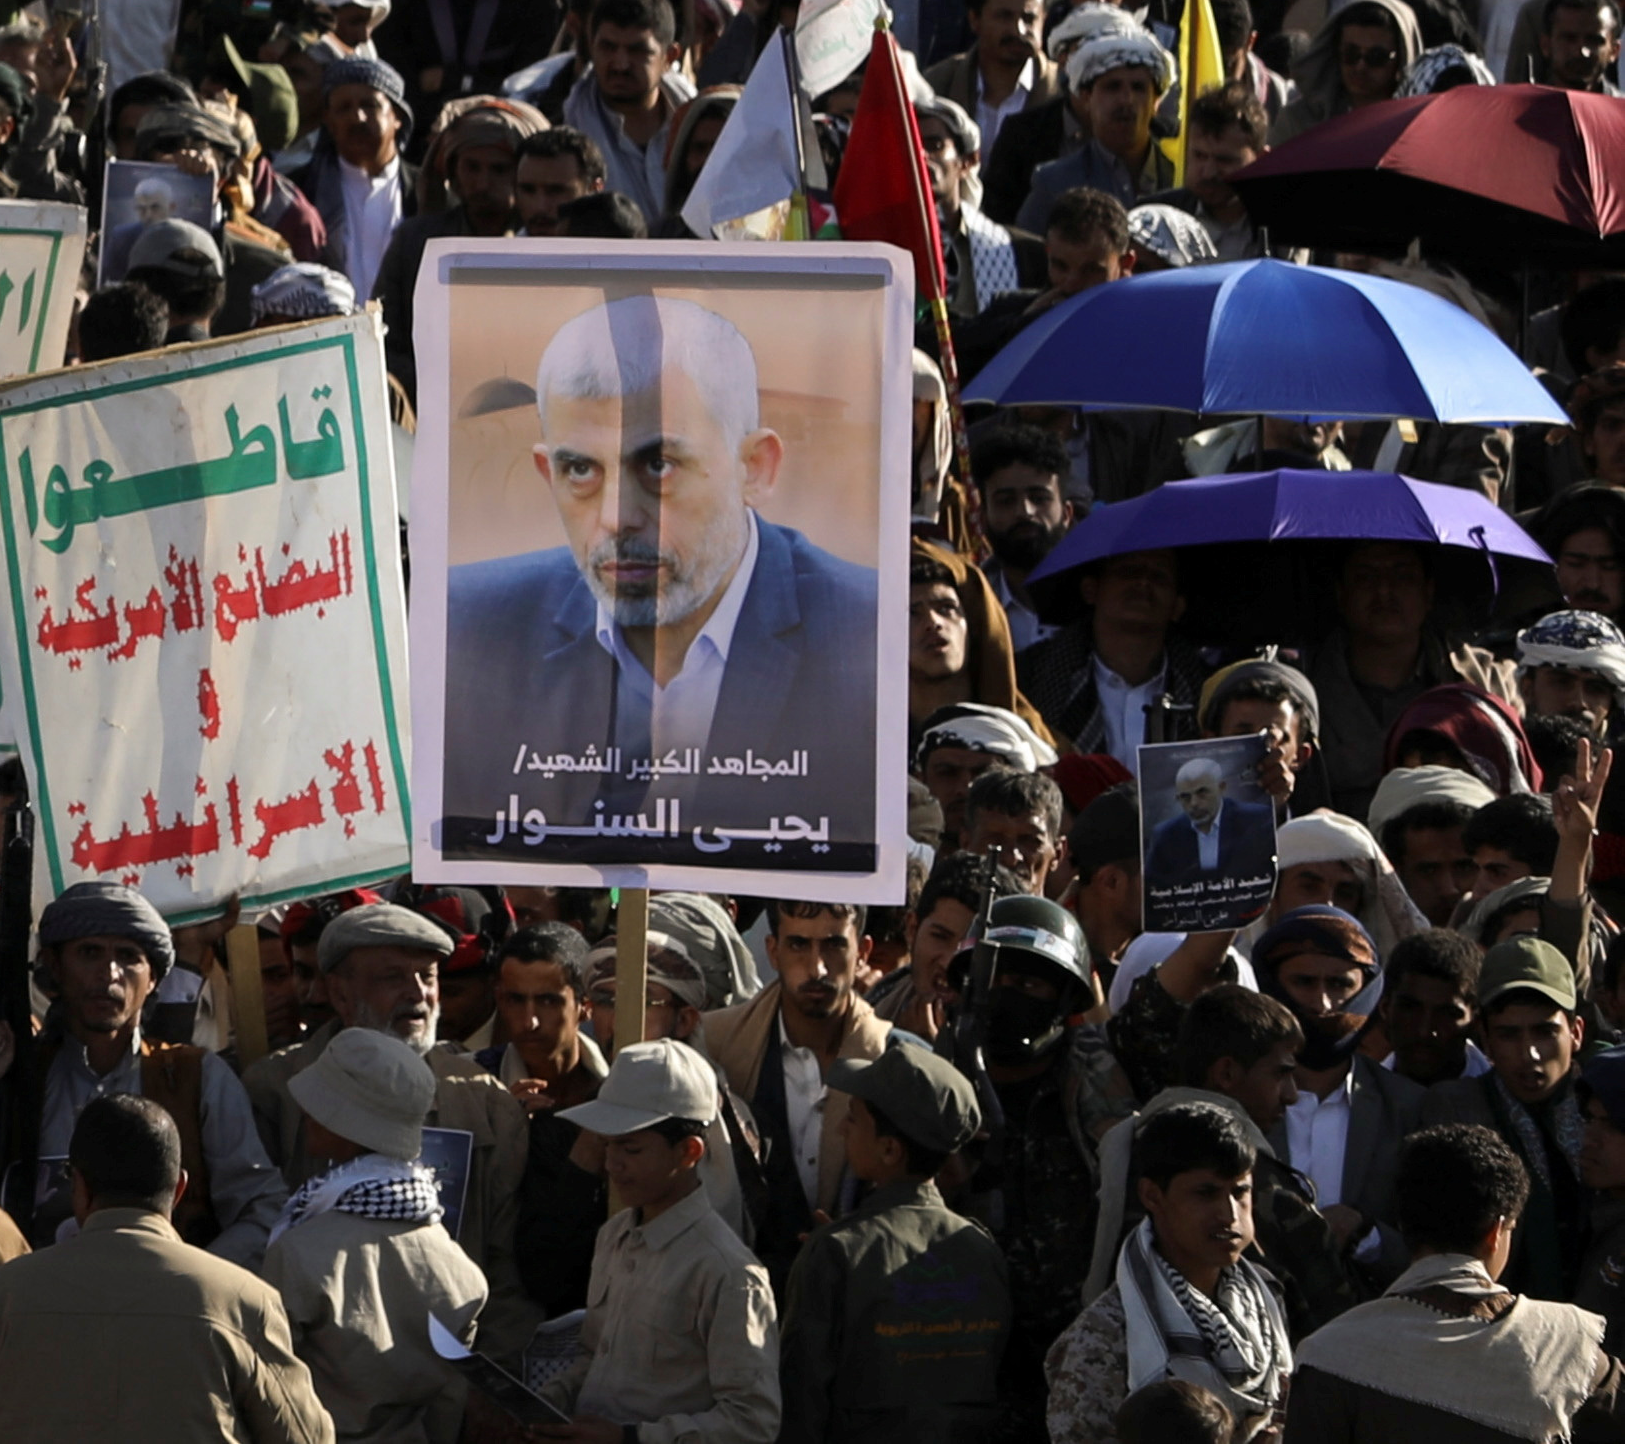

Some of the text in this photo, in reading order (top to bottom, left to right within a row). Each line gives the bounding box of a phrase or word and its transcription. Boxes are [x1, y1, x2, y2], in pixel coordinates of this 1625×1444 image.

[17, 382, 345, 553] قاطعوا
[34, 532, 353, 673] البضائع الأمريكية
[199, 669, 222, 740] و
[626, 748, 700, 781] الكبير
[707, 749, 808, 782] المجاهد
[68, 741, 385, 882] الإسرائيلية
[486, 794, 830, 853] يحيى السنوار
[1207, 877, 1234, 890] الأمة
[1237, 874, 1272, 887] شهيد
